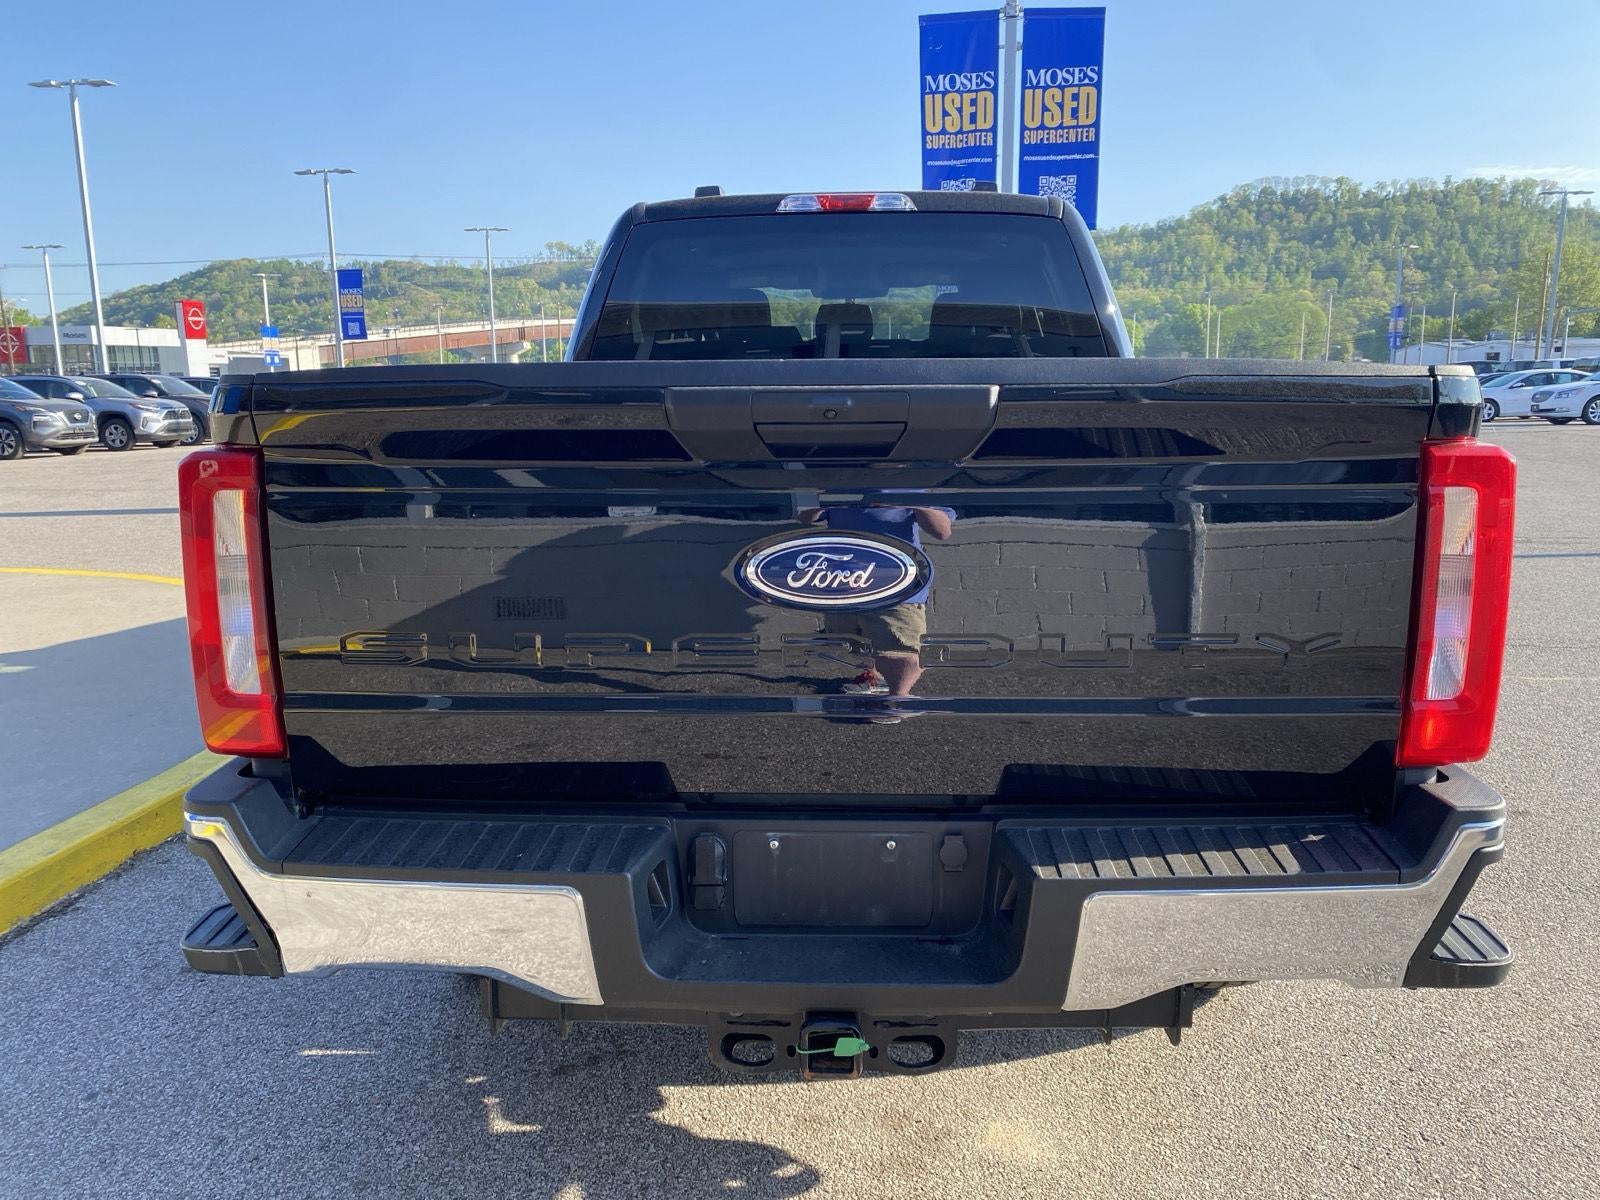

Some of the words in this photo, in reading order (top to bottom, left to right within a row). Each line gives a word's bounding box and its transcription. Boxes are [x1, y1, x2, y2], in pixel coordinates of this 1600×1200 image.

[925, 71, 995, 93] MOSES
[1026, 66, 1098, 87] MOSES
[925, 91, 994, 133] USED
[1024, 86, 1097, 128] USED
[926, 132, 993, 149] SUPERCENTER
[1023, 128, 1095, 145] SUPERCENTER
[927, 157, 993, 166] mosesusedsupercenter.com
[1023, 153, 1095, 162] mosesusedsupercenter.com
[341, 295, 363, 308] USED
[786, 551, 876, 588] Ford
[339, 631, 873, 668] SUPER
[919, 632, 1344, 669] DUTY
